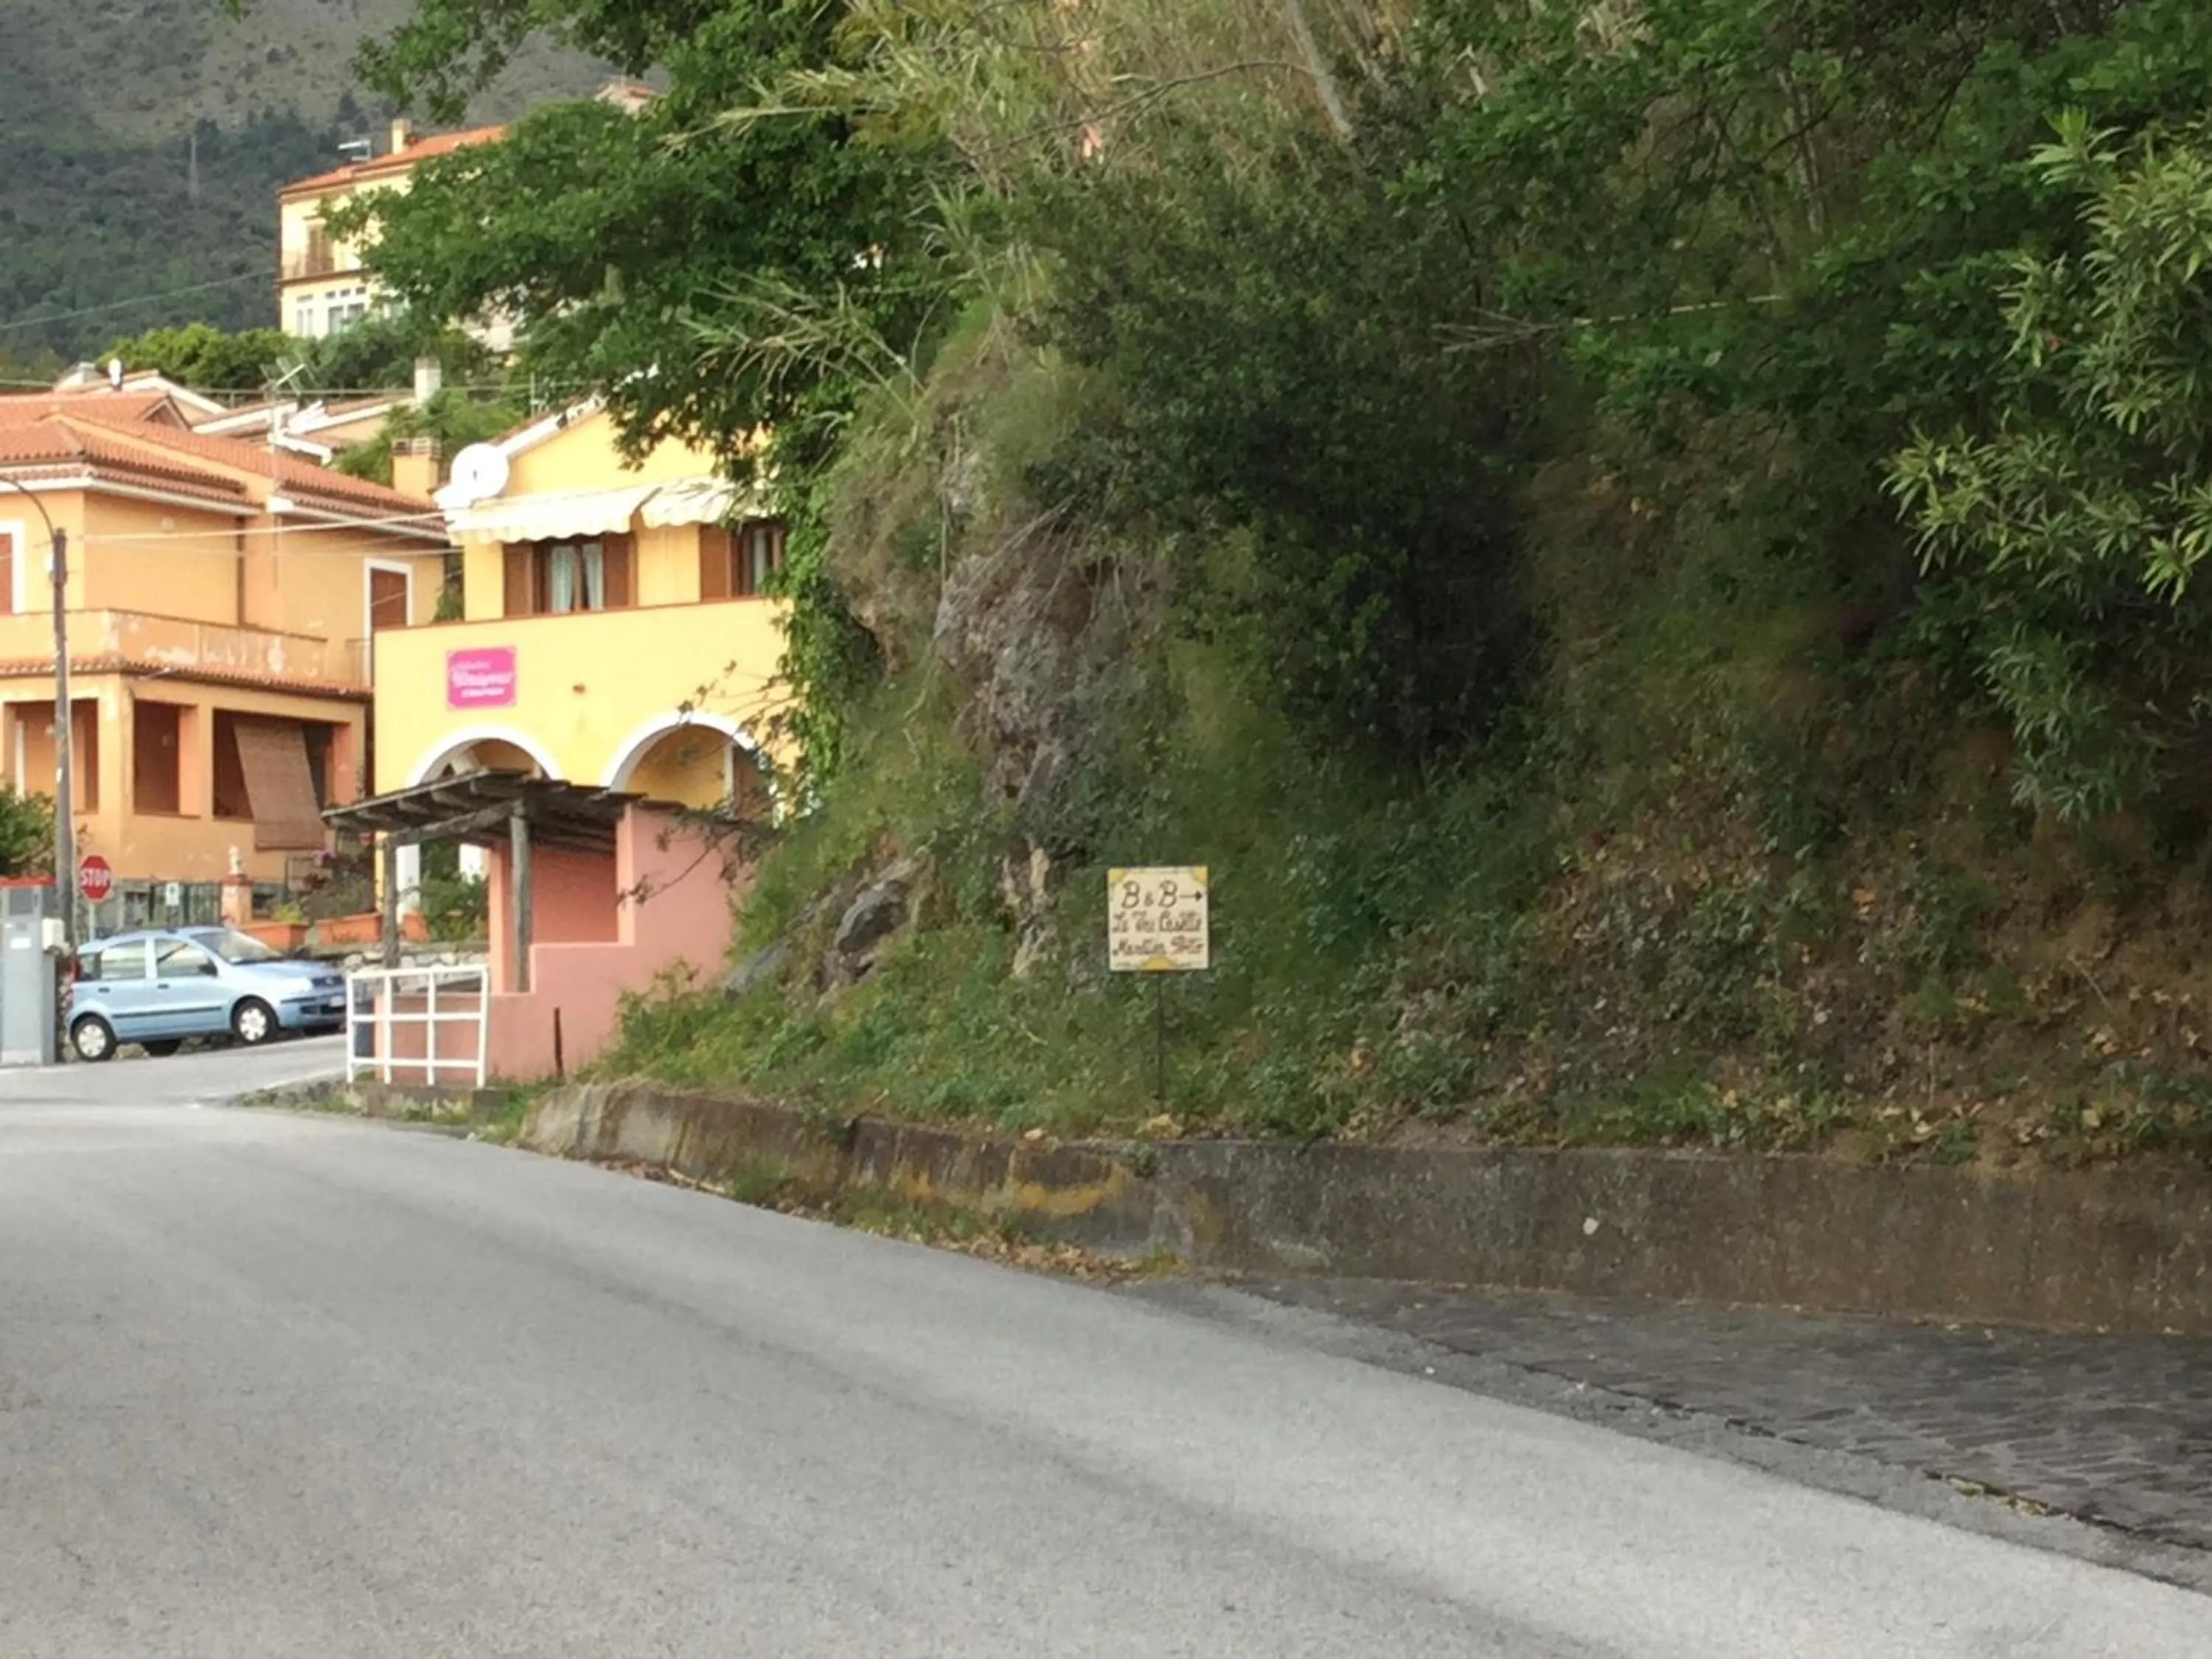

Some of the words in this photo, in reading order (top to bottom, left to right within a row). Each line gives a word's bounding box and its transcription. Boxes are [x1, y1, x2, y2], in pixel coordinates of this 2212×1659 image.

[80, 868, 111, 888] STOP
[1121, 880, 1141, 909] B
[1158, 880, 1178, 908] B
